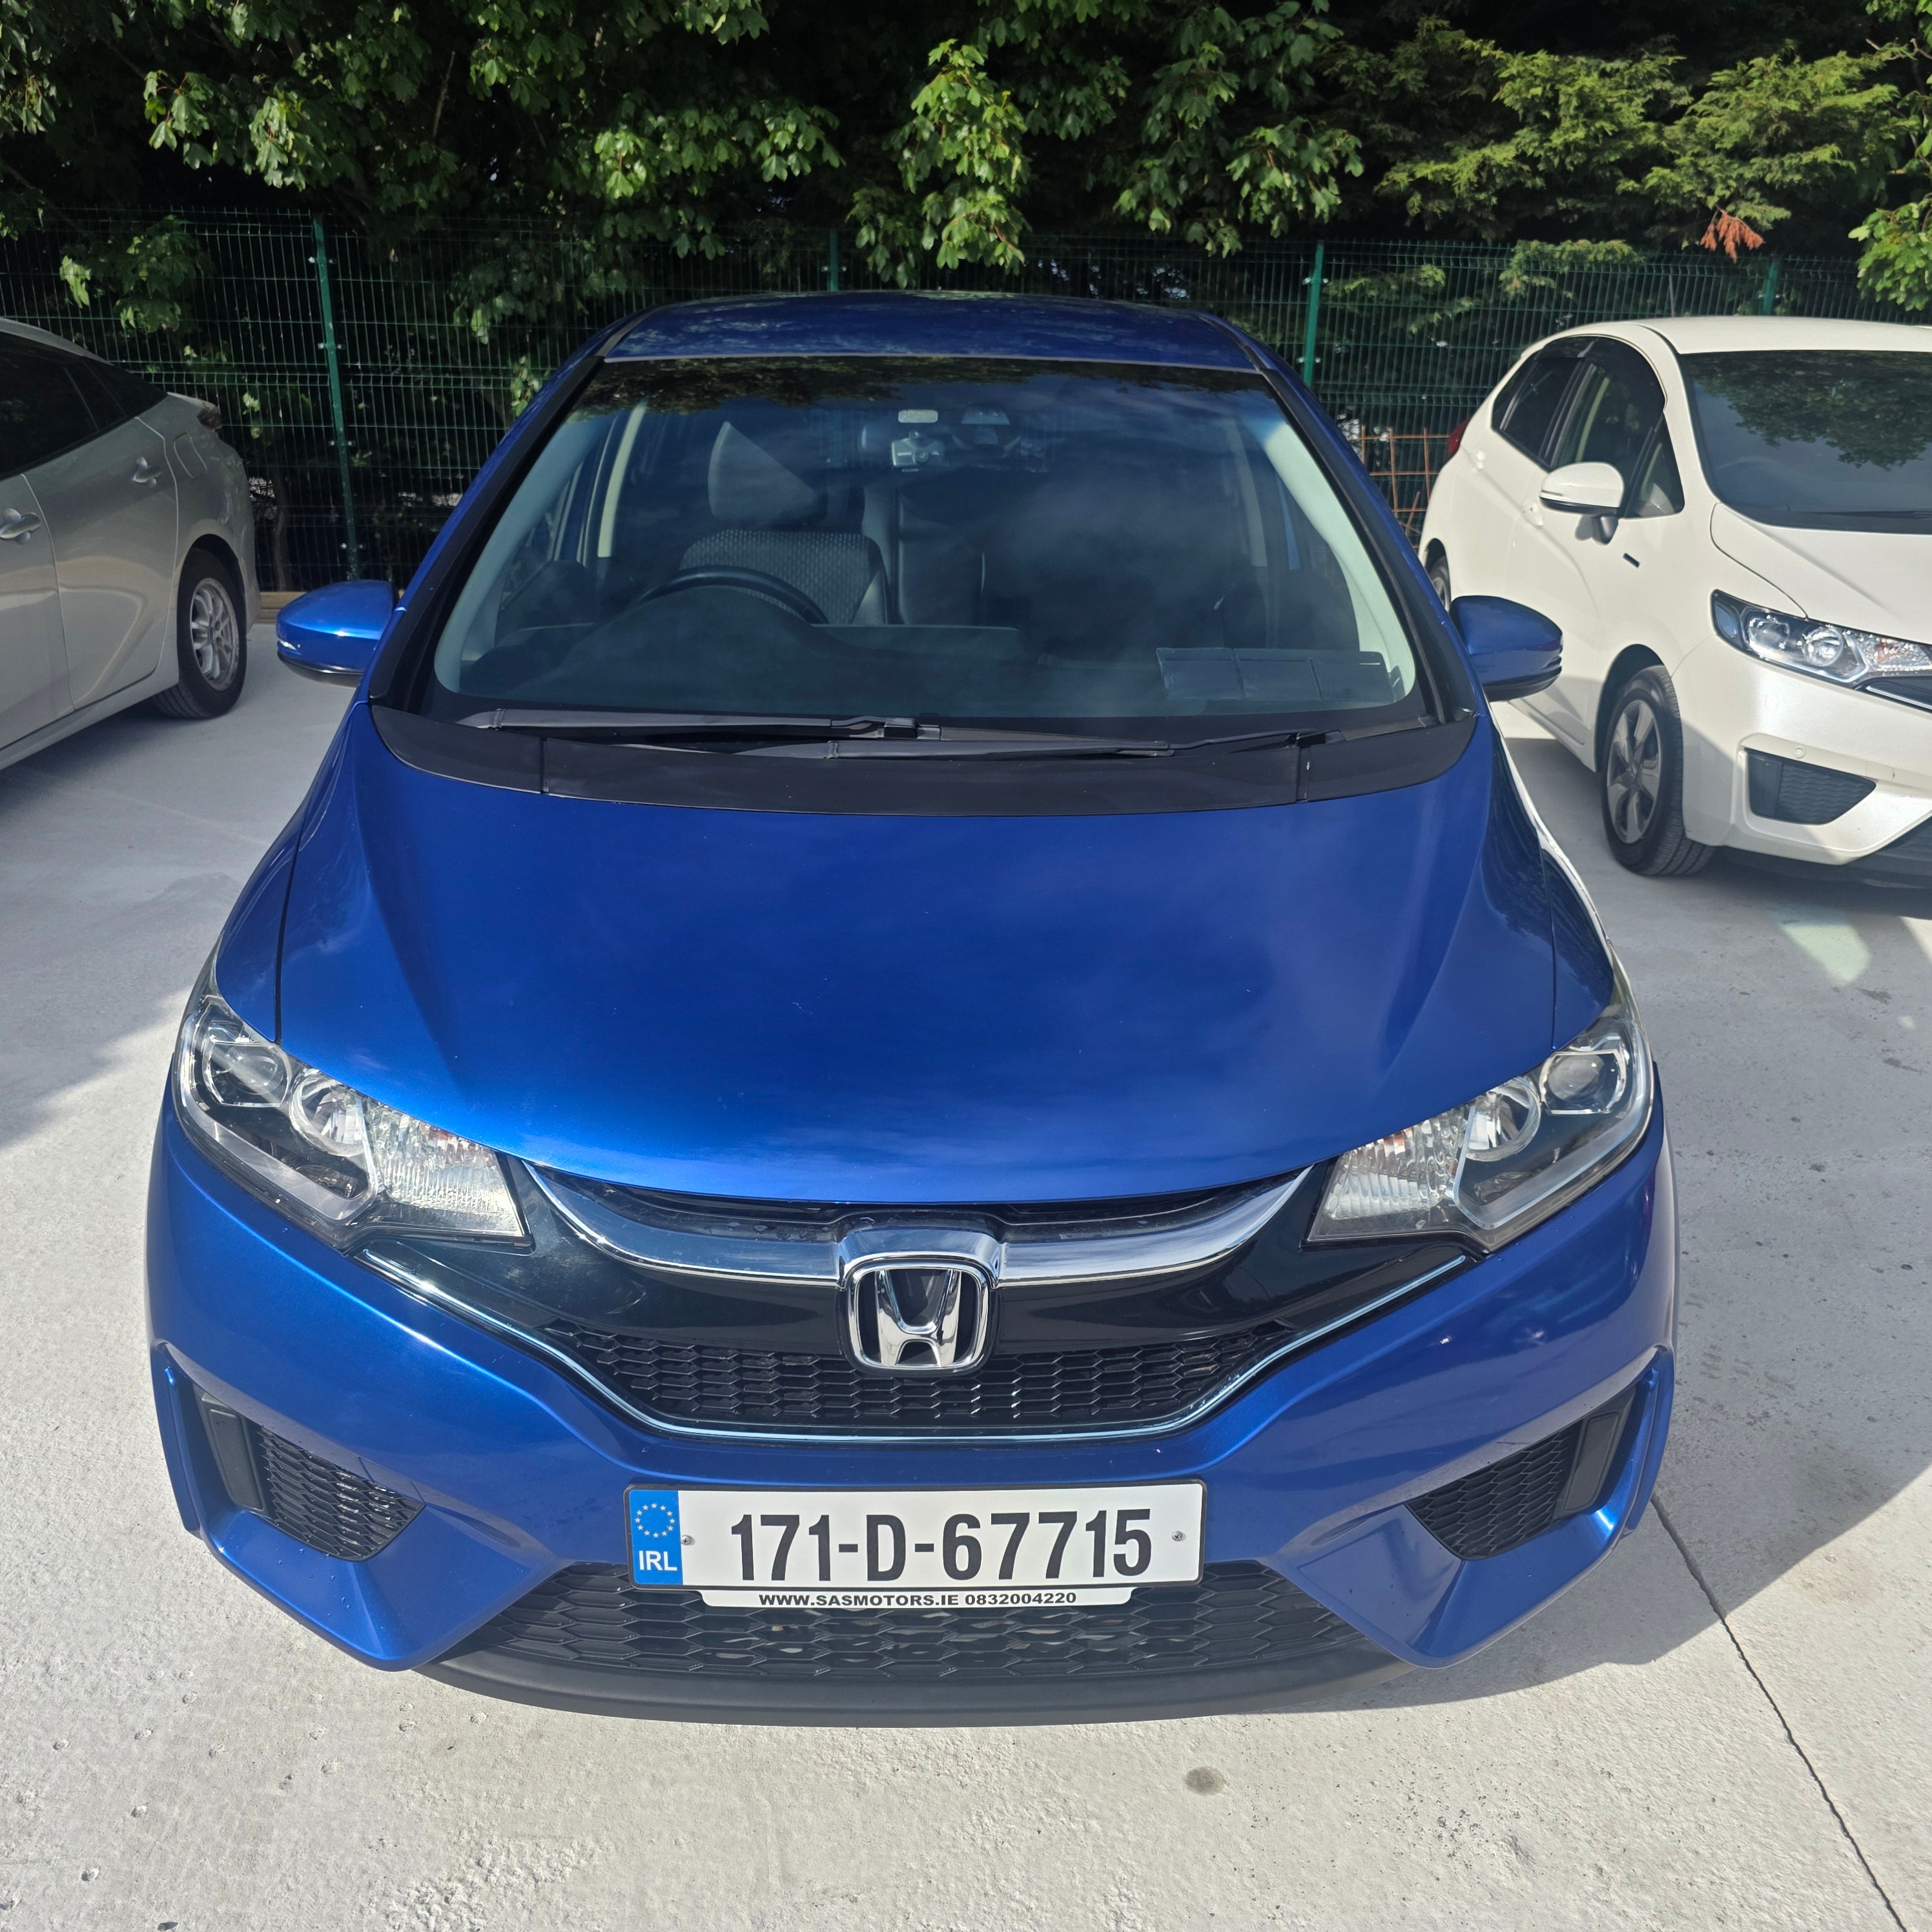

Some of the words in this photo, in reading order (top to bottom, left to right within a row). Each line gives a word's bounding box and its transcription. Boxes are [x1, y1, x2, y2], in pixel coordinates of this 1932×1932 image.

[731, 1508, 1151, 1581] 171-D-67715
[639, 1550, 677, 1571] IRL
[759, 1594, 959, 1606] WWW.SASMOTORS.IE
[965, 1592, 1077, 1605] 0832004220
